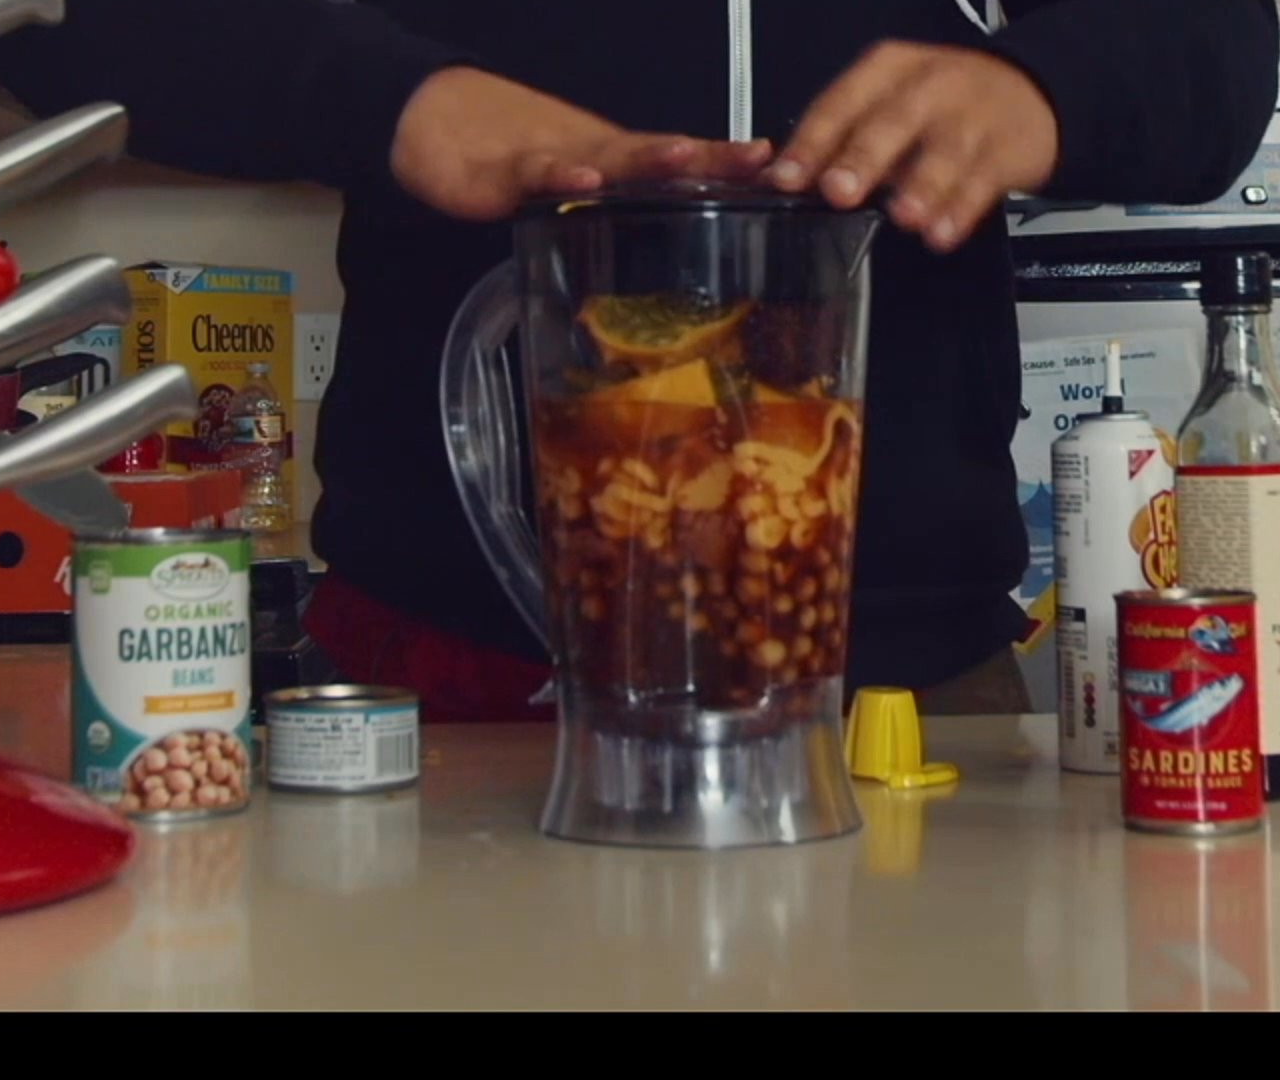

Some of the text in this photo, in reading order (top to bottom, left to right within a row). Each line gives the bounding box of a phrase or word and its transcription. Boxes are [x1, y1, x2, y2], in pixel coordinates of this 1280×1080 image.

[192, 314, 275, 353] Cheerios
[144, 600, 234, 622] ORGANIC
[172, 667, 216, 689] BEANS
[1128, 748, 1254, 775] SARDINES
[1207, 776, 1243, 789] SAUCE
